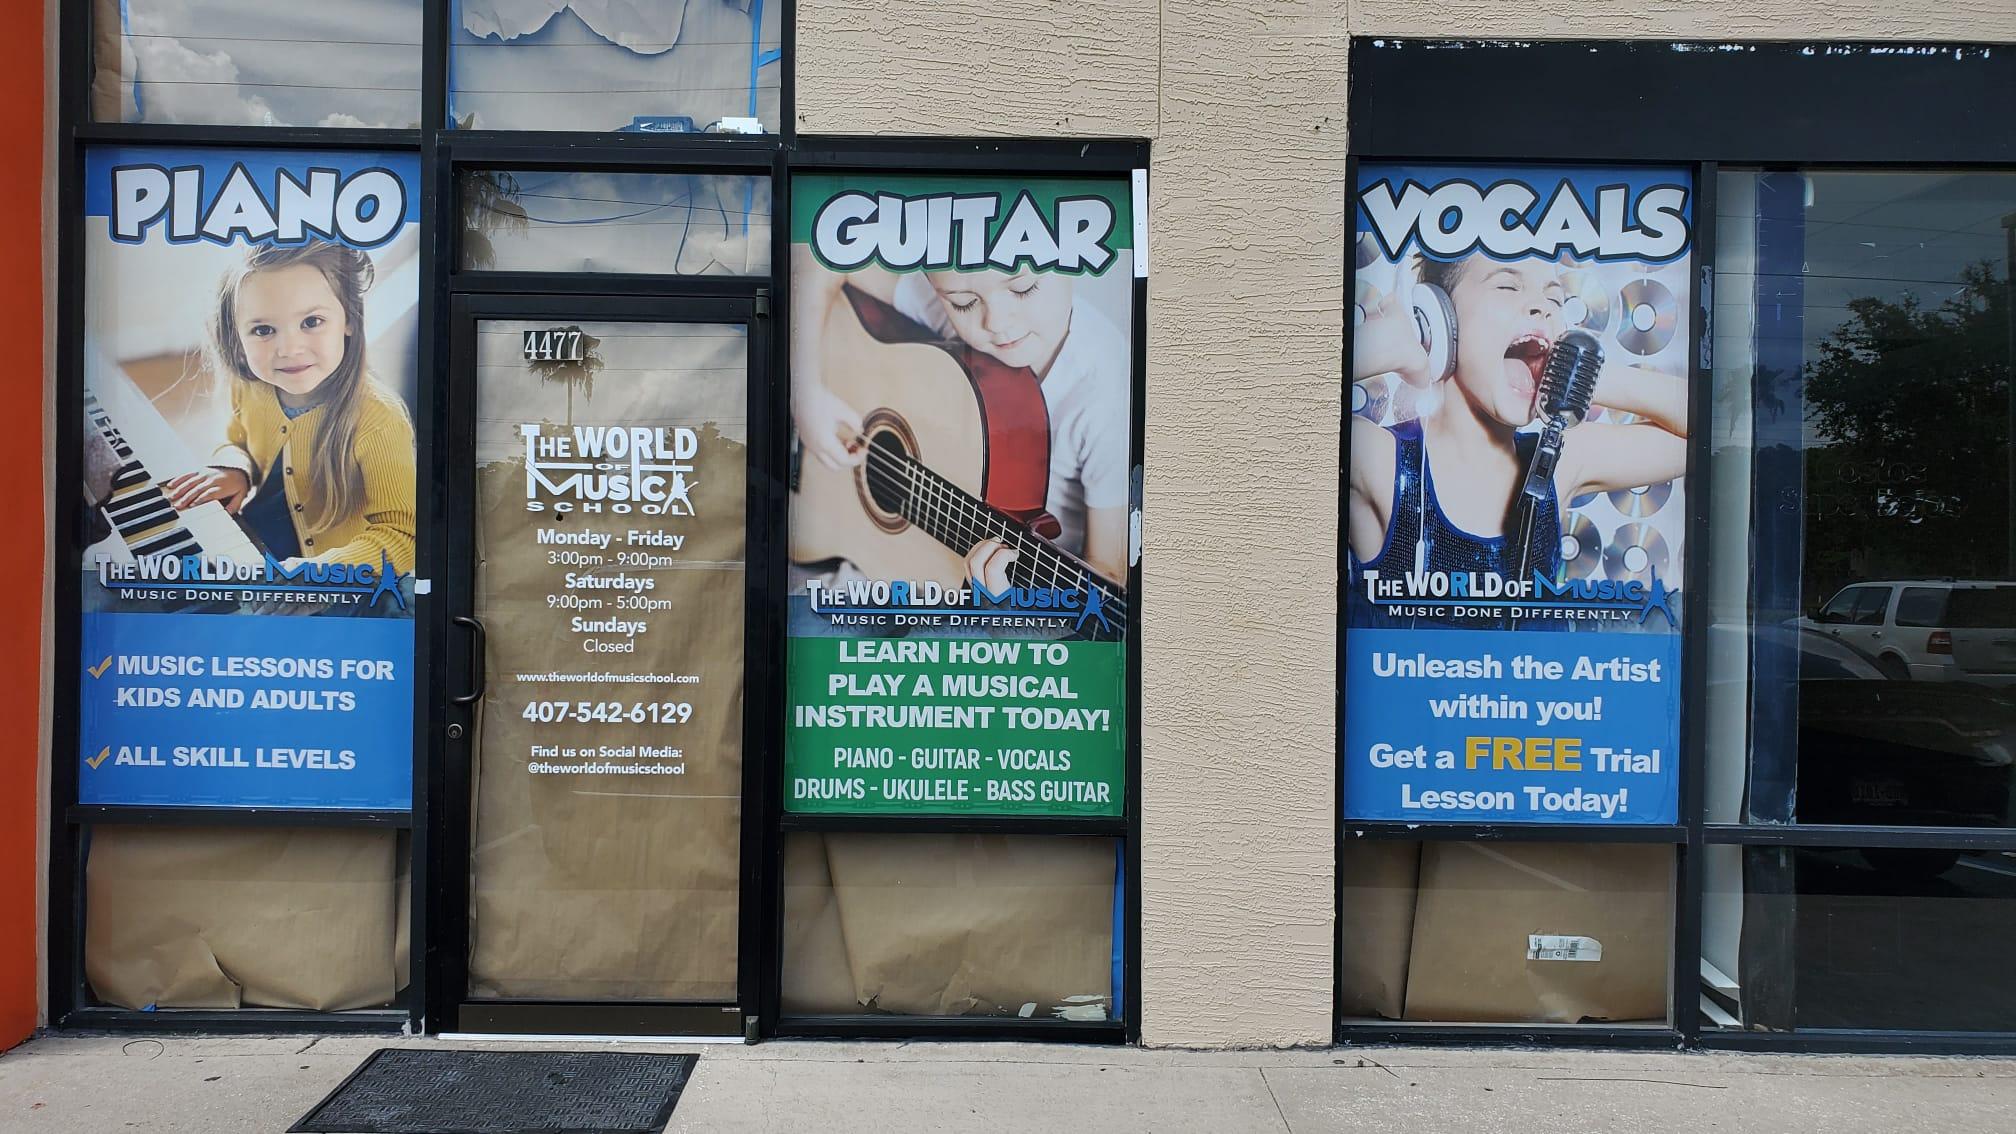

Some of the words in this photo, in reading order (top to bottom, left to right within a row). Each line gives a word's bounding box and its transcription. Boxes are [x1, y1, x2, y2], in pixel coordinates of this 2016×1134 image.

[113, 164, 404, 245] PIANO
[813, 191, 1114, 271] GUITAR
[1359, 179, 1689, 259] VOCALS
[524, 331, 582, 360] 4477
[574, 426, 698, 459] WORLD
[595, 463, 631, 471] OF
[526, 466, 667, 501] MUSIC
[526, 501, 688, 516] SCHOOL
[537, 529, 612, 549] Monday
[627, 530, 684, 550] Friday
[138, 554, 234, 581] WORLD
[236, 561, 265, 581] OF
[264, 551, 374, 585] MUSIC
[547, 551, 603, 568] 3:00pm
[617, 552, 672, 569] 9:00pm
[565, 572, 655, 593] Saturdays
[848, 580, 942, 606] WORLD
[944, 588, 972, 606] OF
[972, 577, 1079, 609] MUSIC
[1406, 571, 1503, 598] WORLD
[1504, 580, 1534, 598] OF
[1534, 568, 1644, 600] MUSIC
[120, 588, 178, 601] MUSIC
[185, 589, 235, 602] DONE
[242, 590, 362, 604] DIFFERENTLY
[547, 595, 602, 612] 9:00pm
[616, 596, 672, 613] 5:00pm
[831, 614, 887, 626] MUSIC
[895, 614, 942, 626] DONE
[949, 615, 1068, 628] DIFFERENTLY
[1388, 606, 1446, 617] MUSIC
[1454, 606, 1502, 618] DONE
[1510, 607, 1632, 621] DIFFERENTLY
[571, 616, 647, 636] Sundays
[583, 639, 634, 653] Closed
[839, 641, 940, 663] LEARN
[948, 641, 1021, 664] HOW
[1028, 643, 1069, 665] TO
[118, 655, 204, 676] MUSIC
[212, 657, 333, 678] LESSONS
[341, 659, 395, 681] FOR
[516, 672, 700, 684] www.theworldofmusicschool.com
[1372, 652, 1502, 679] Unleash
[1511, 655, 1564, 680] the
[1571, 656, 1661, 683] Artist
[828, 673, 906, 696] PLAY
[912, 674, 935, 697] A
[942, 675, 1078, 699] MUSICAL
[117, 687, 181, 708] KIDS
[187, 688, 245, 709] AND
[251, 689, 356, 711] ADULTS
[1429, 694, 1528, 720] within
[1536, 696, 1602, 726] you!
[522, 701, 693, 724] 407-542-6129
[795, 705, 996, 729] INSTRUMENT
[1002, 706, 1110, 731] TODAY!
[115, 746, 166, 767] ALL
[173, 747, 249, 768] SKILL
[256, 748, 356, 770] LEVELS
[531, 746, 558, 757] Find
[562, 748, 576, 757] us
[579, 748, 595, 757] on
[599, 746, 636, 758] Social
[639, 746, 683, 758] Media:
[834, 747, 893, 769] PIANO
[911, 748, 980, 770] GUITAR
[998, 749, 1071, 771] VOCALS
[1369, 743, 1427, 769] Get
[1435, 750, 1455, 769] a
[1465, 736, 1582, 772] FREE
[1590, 748, 1660, 774] Trial
[528, 762, 685, 775] @theworldofmusicschool
[794, 778, 865, 799] DRUMS
[883, 778, 968, 801] UKULELE
[987, 780, 1036, 801] BASS
[1040, 781, 1110, 803] GUITAR
[1402, 784, 1514, 810] Lesson
[1523, 786, 1628, 818] Today!
